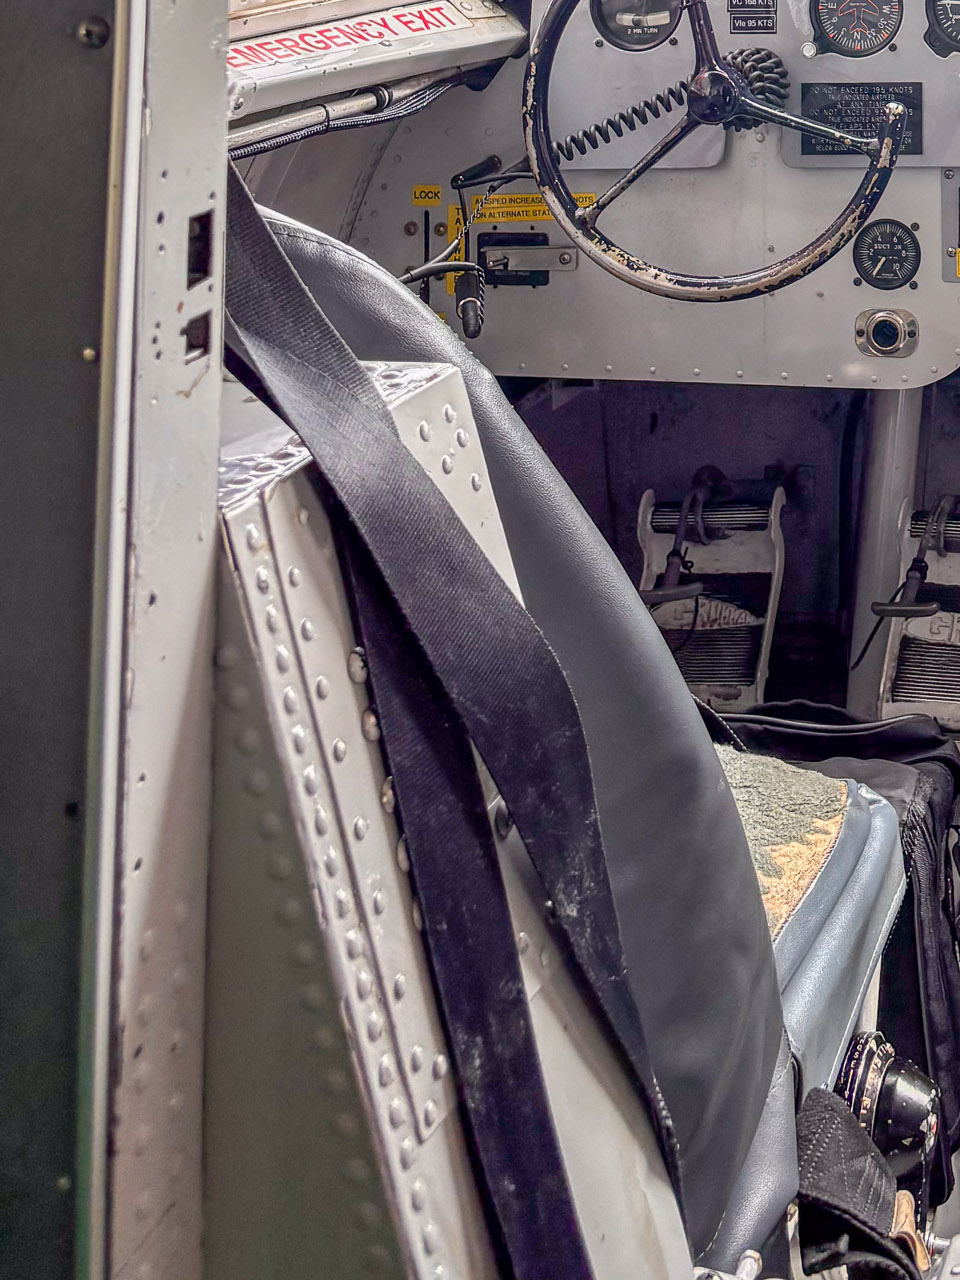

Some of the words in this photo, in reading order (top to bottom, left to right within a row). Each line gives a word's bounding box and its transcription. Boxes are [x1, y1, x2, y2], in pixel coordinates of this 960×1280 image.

[226, 17, 399, 68] EMERGENCY
[393, 7, 456, 33] EXIT
[414, 190, 441, 200] LOCK
